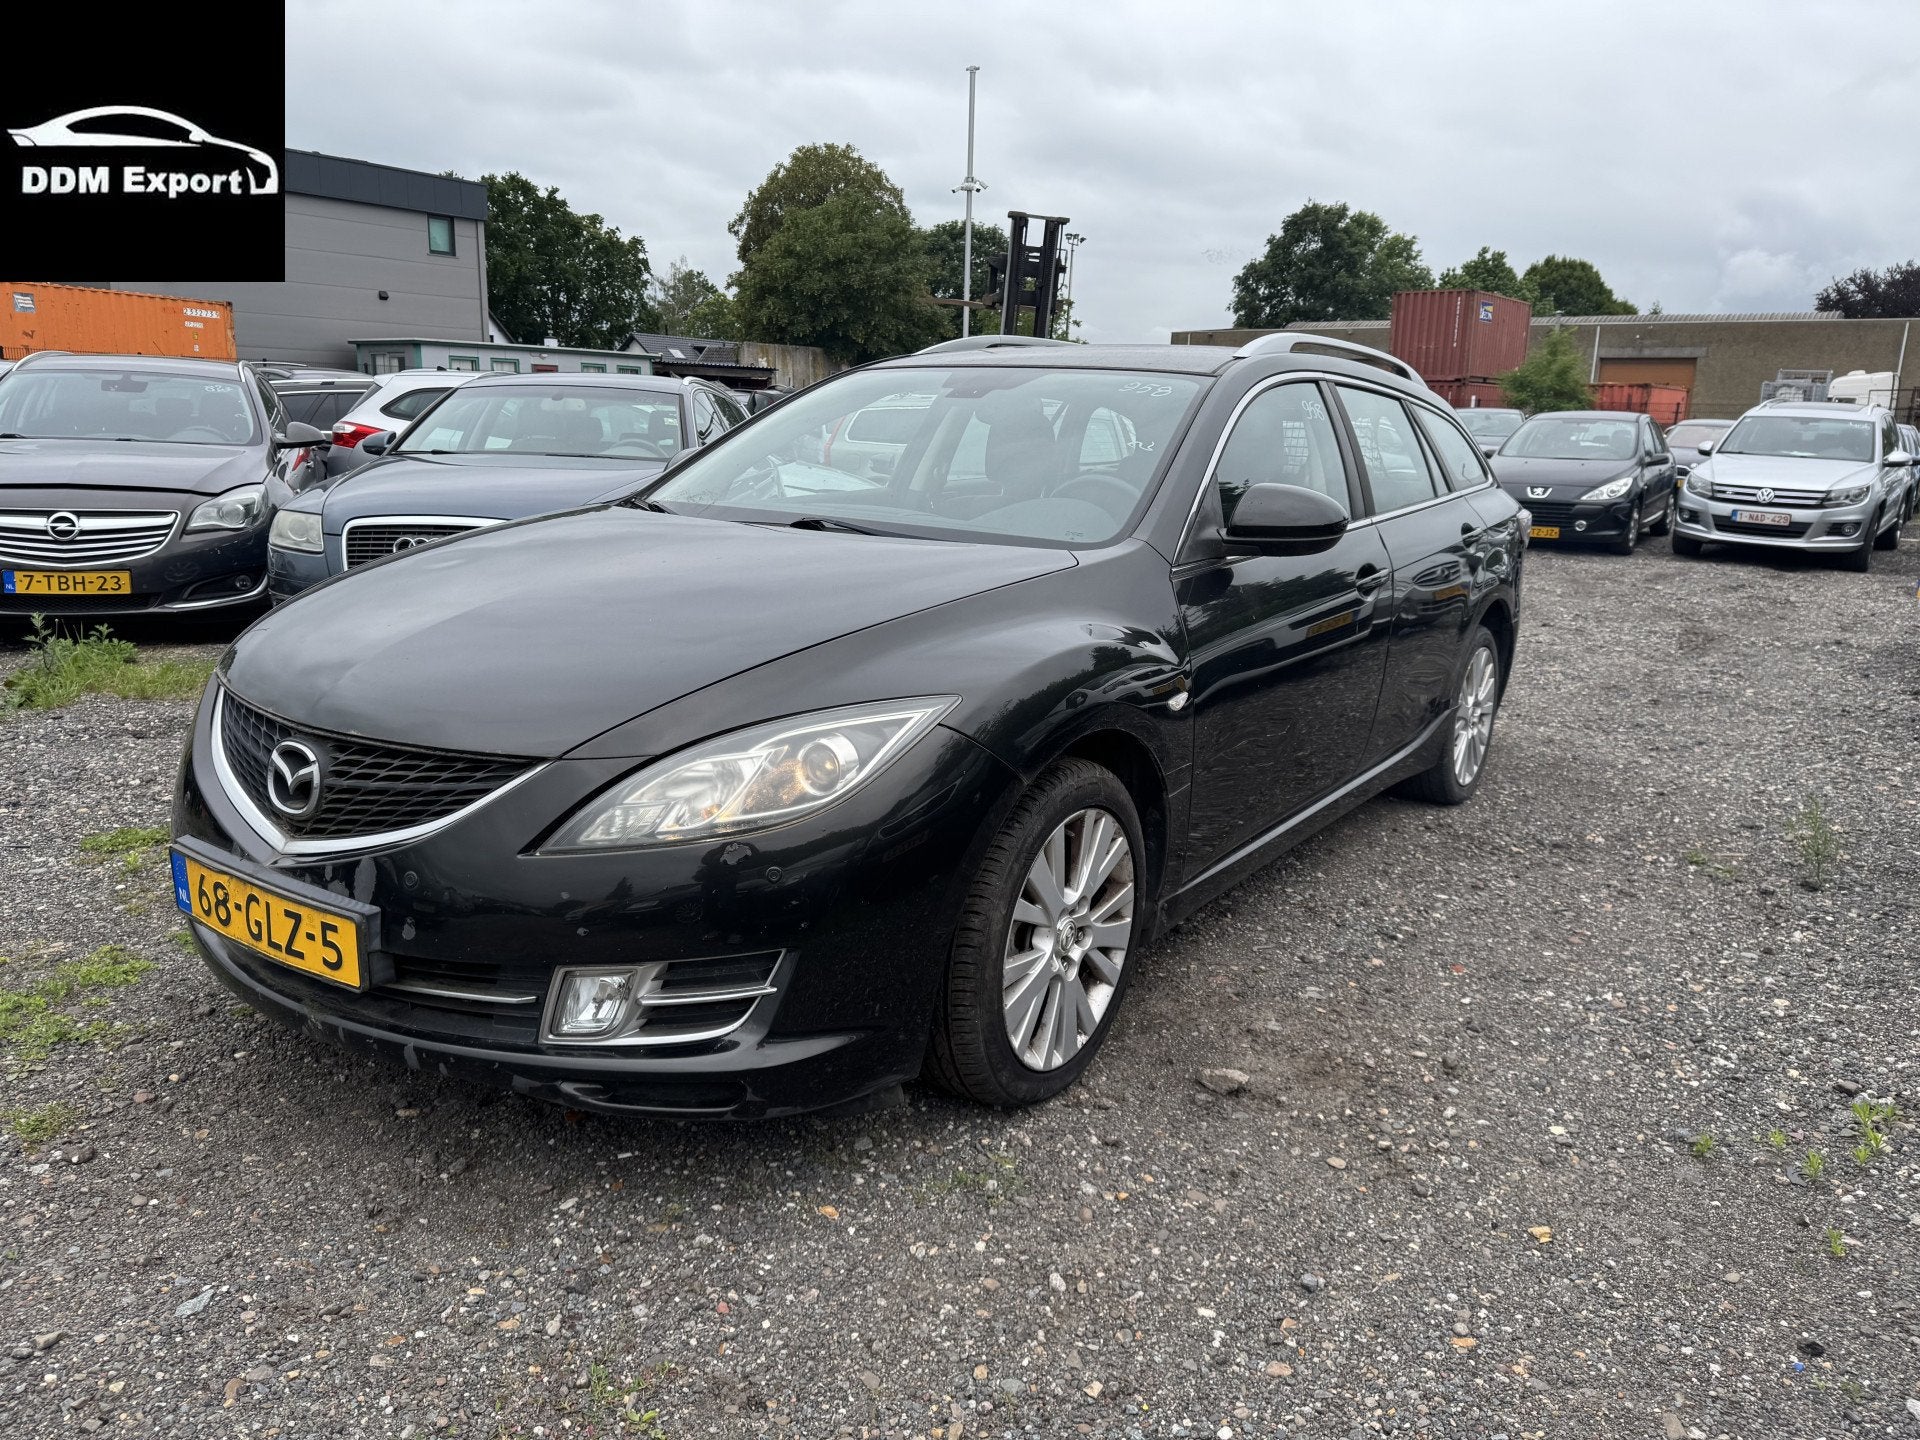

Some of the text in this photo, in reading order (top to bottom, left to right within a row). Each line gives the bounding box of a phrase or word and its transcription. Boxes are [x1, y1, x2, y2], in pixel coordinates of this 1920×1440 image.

[1301, 400, 1325, 420] 958
[1740, 512, 1789, 524] 1-NAD-429
[22, 574, 122, 592] 7-TBH-23
[178, 873, 343, 971] NL 68-GLZ-5
